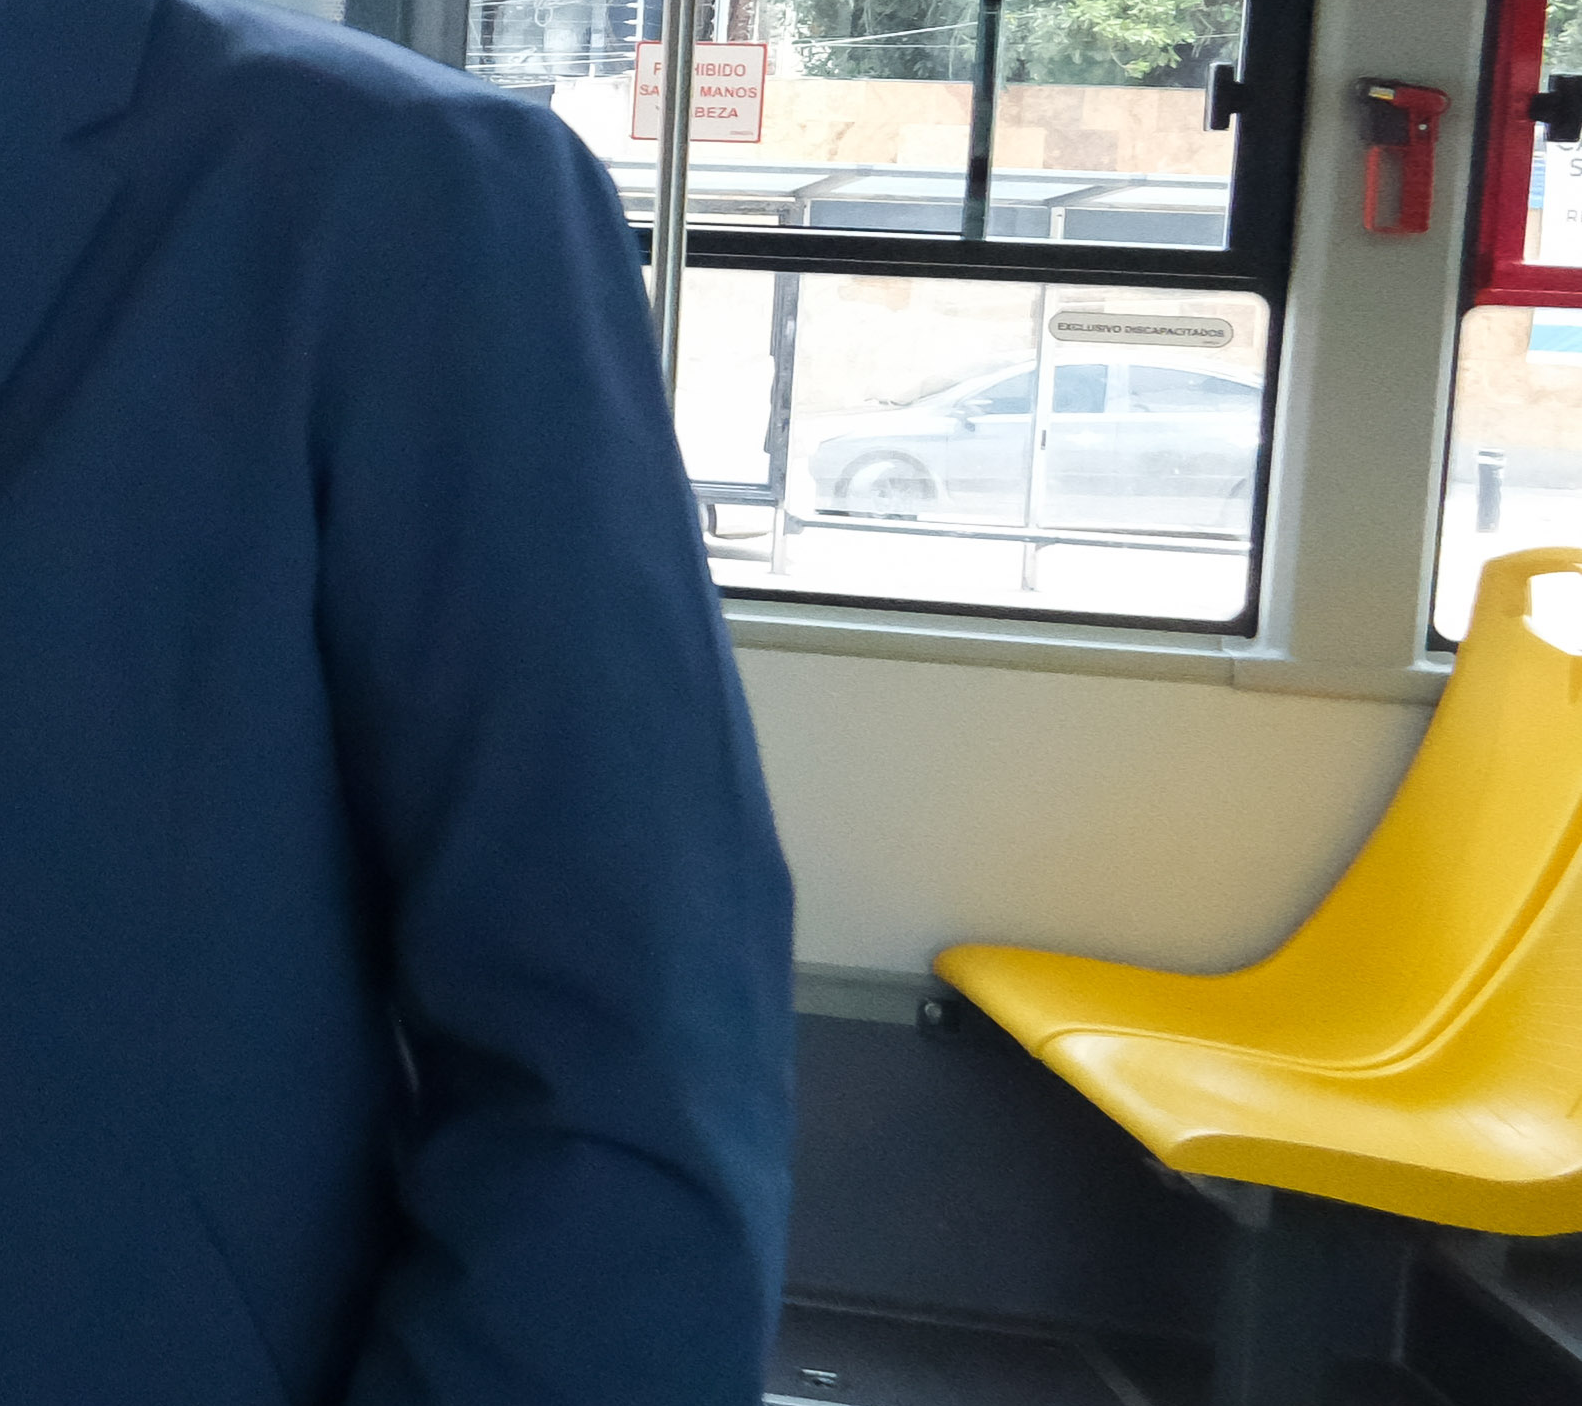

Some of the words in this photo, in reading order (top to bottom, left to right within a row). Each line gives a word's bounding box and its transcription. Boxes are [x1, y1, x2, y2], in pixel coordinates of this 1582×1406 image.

[653, 61, 747, 78] PHIBIDO
[699, 85, 758, 99] MANOS
[1057, 322, 1122, 334] EXCLUSIVO
[1124, 325, 1226, 338] DISCAPACITADOS
